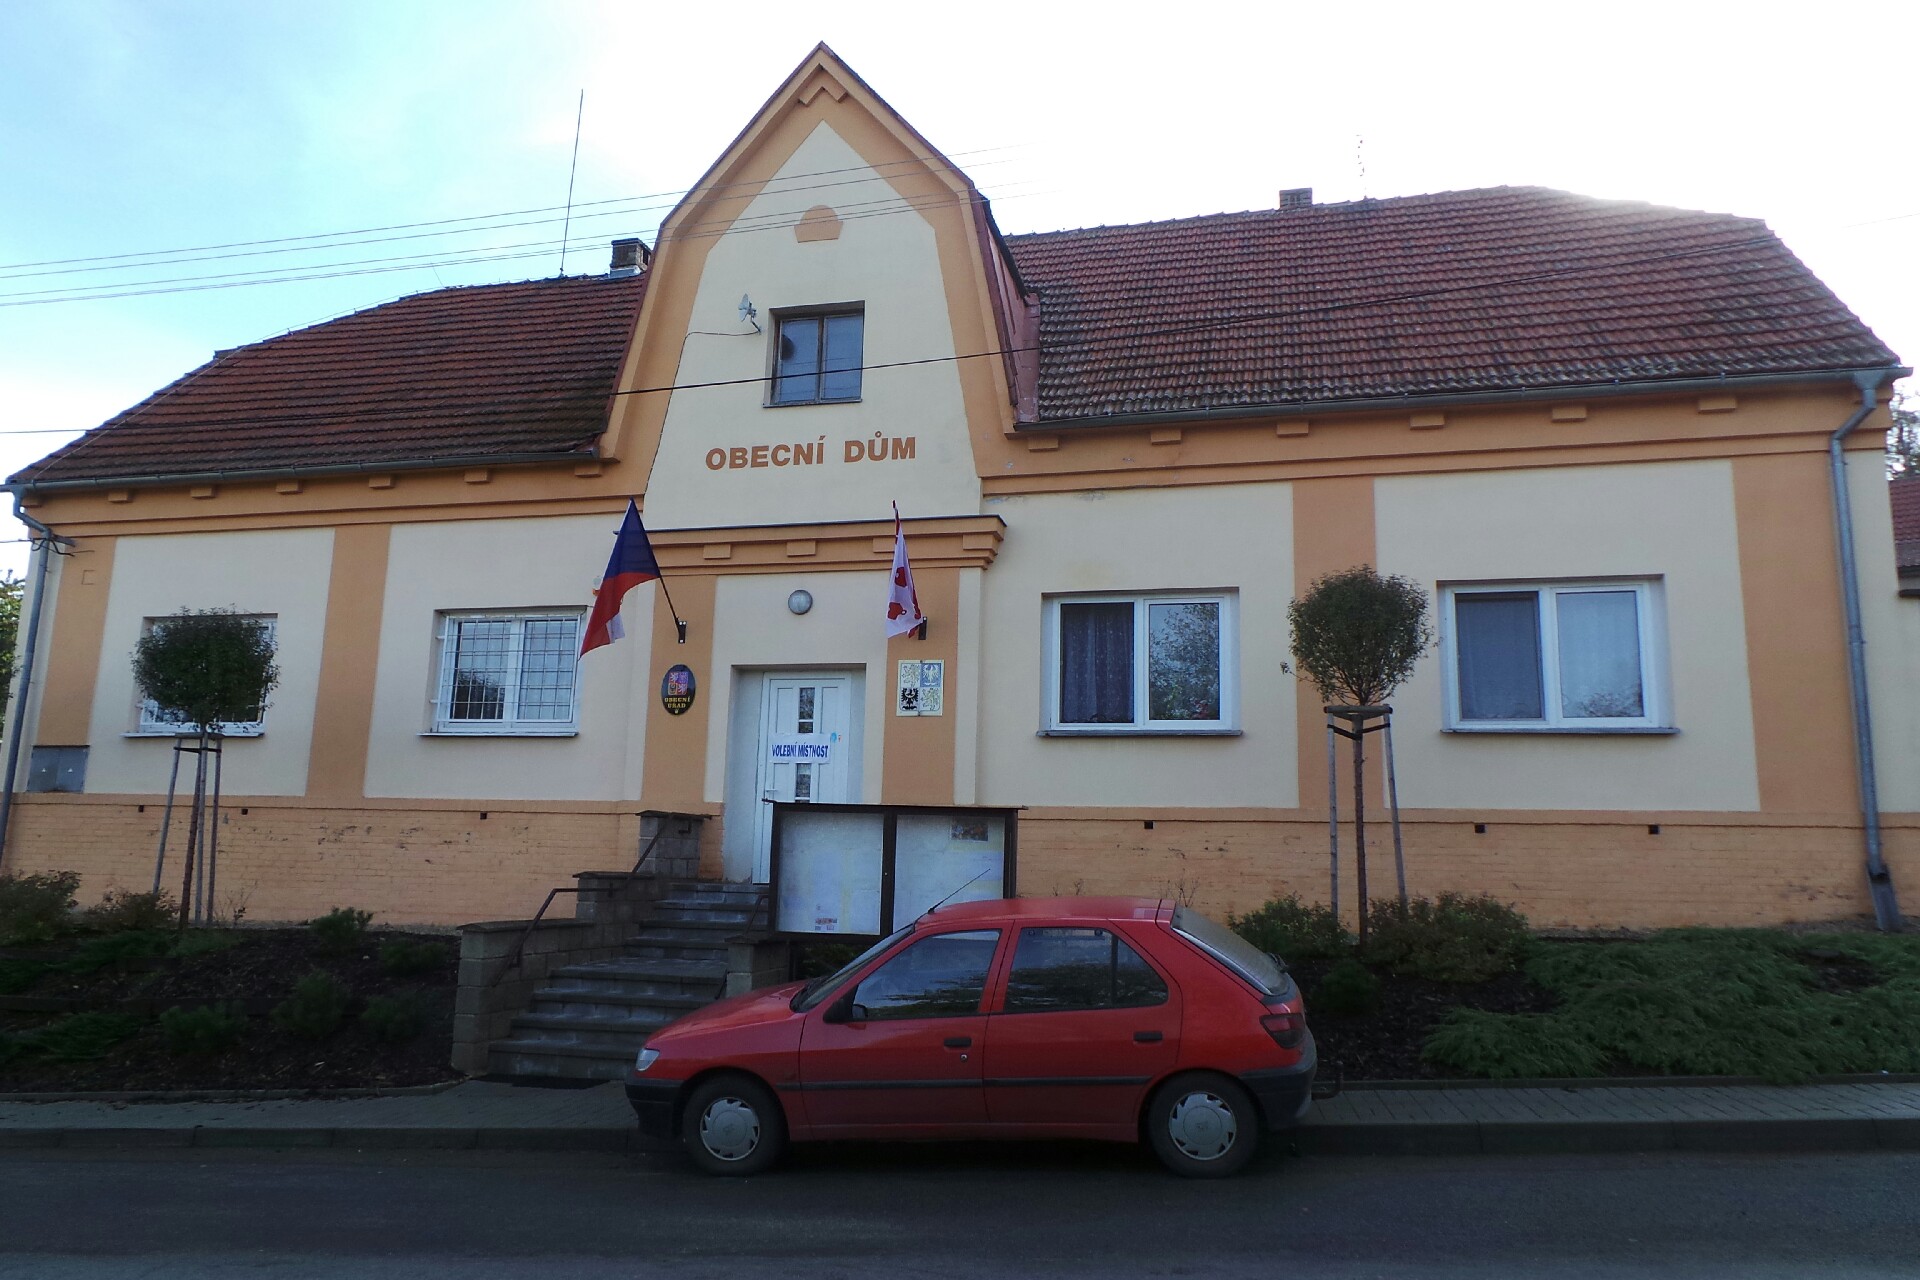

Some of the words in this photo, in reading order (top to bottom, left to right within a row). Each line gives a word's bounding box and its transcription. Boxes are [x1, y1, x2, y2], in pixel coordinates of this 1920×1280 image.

[705, 435, 826, 471] OBECNÍ
[843, 430, 916, 463] DŮM
[771, 741, 798, 757] VOLEBNÍ
[797, 742, 829, 758] MÍSTNOST
